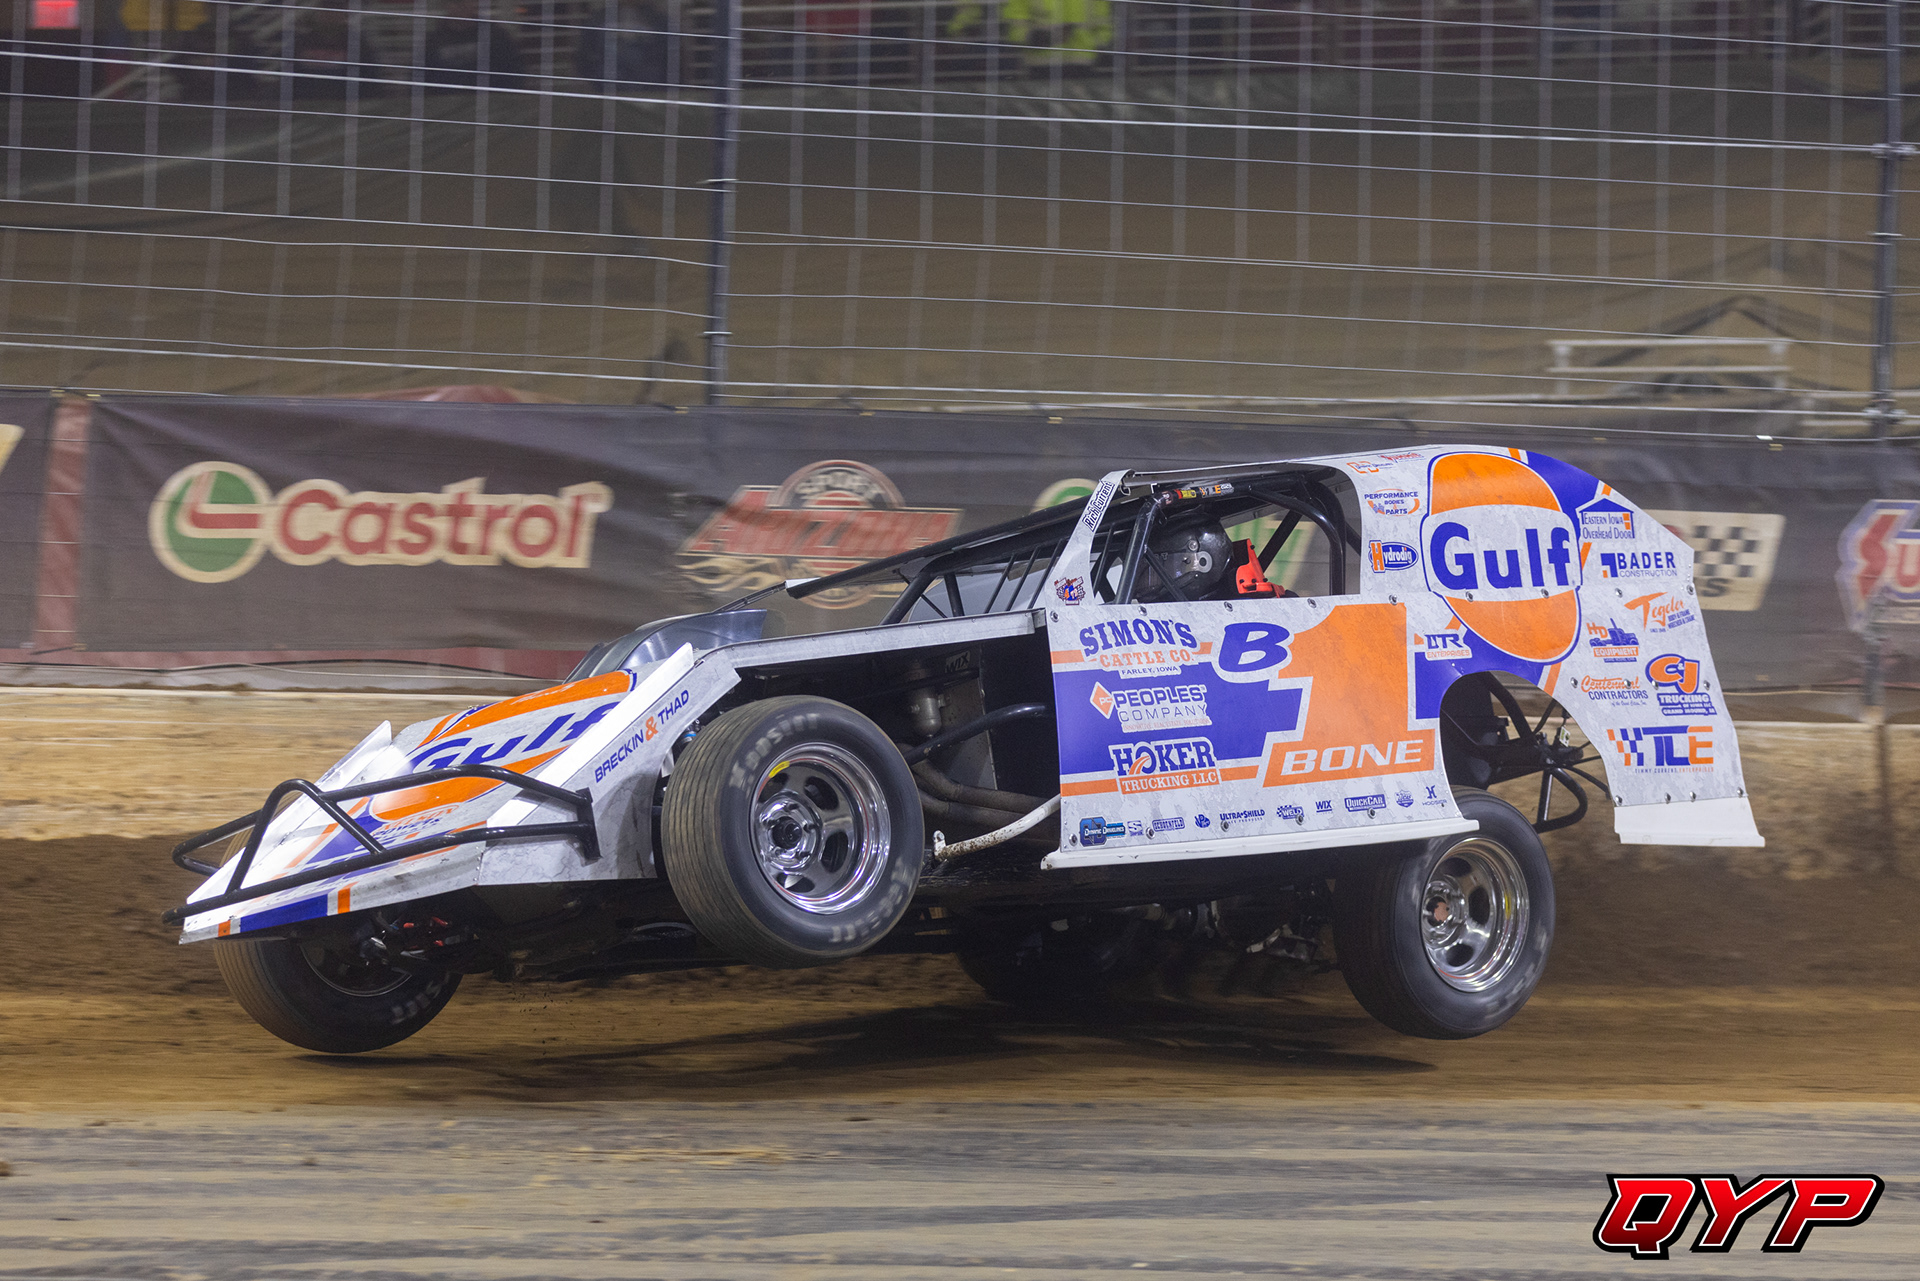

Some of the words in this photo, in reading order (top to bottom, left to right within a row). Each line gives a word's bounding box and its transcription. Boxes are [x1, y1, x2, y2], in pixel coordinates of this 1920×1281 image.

[1364, 491, 1418, 499] PERFORMANCE
[280, 488, 582, 558] Castrol
[1370, 541, 1413, 572] Hydrodig
[1430, 522, 1571, 590] Gulf
[1617, 551, 1676, 570] BADER
[1619, 568, 1678, 577] CONSTRUCTION
[1079, 618, 1198, 657] SIMON'S
[1218, 621, 1290, 672] B
[1099, 650, 1166, 668] CATTLE
[1169, 648, 1195, 663] CO.
[1426, 649, 1470, 659] ENTERPRISES
[1595, 647, 1638, 656] EQUIPMENT
[1121, 667, 1156, 676] FARLEY,
[1156, 665, 1178, 673] IOWA
[1588, 689, 1649, 701] CONTRACTORS
[1658, 694, 1710, 704] TRUCKING
[1119, 703, 1207, 722] COMPANY
[594, 729, 644, 783] BRECKIN
[645, 716, 659, 741] &
[658, 689, 690, 724] THAD
[1112, 740, 1216, 776] HOKER
[1280, 739, 1424, 776] BONE
[1121, 776, 1190, 792] TRUCKING
[1191, 771, 1217, 785] LLC
[1315, 800, 1332, 810] WIX
